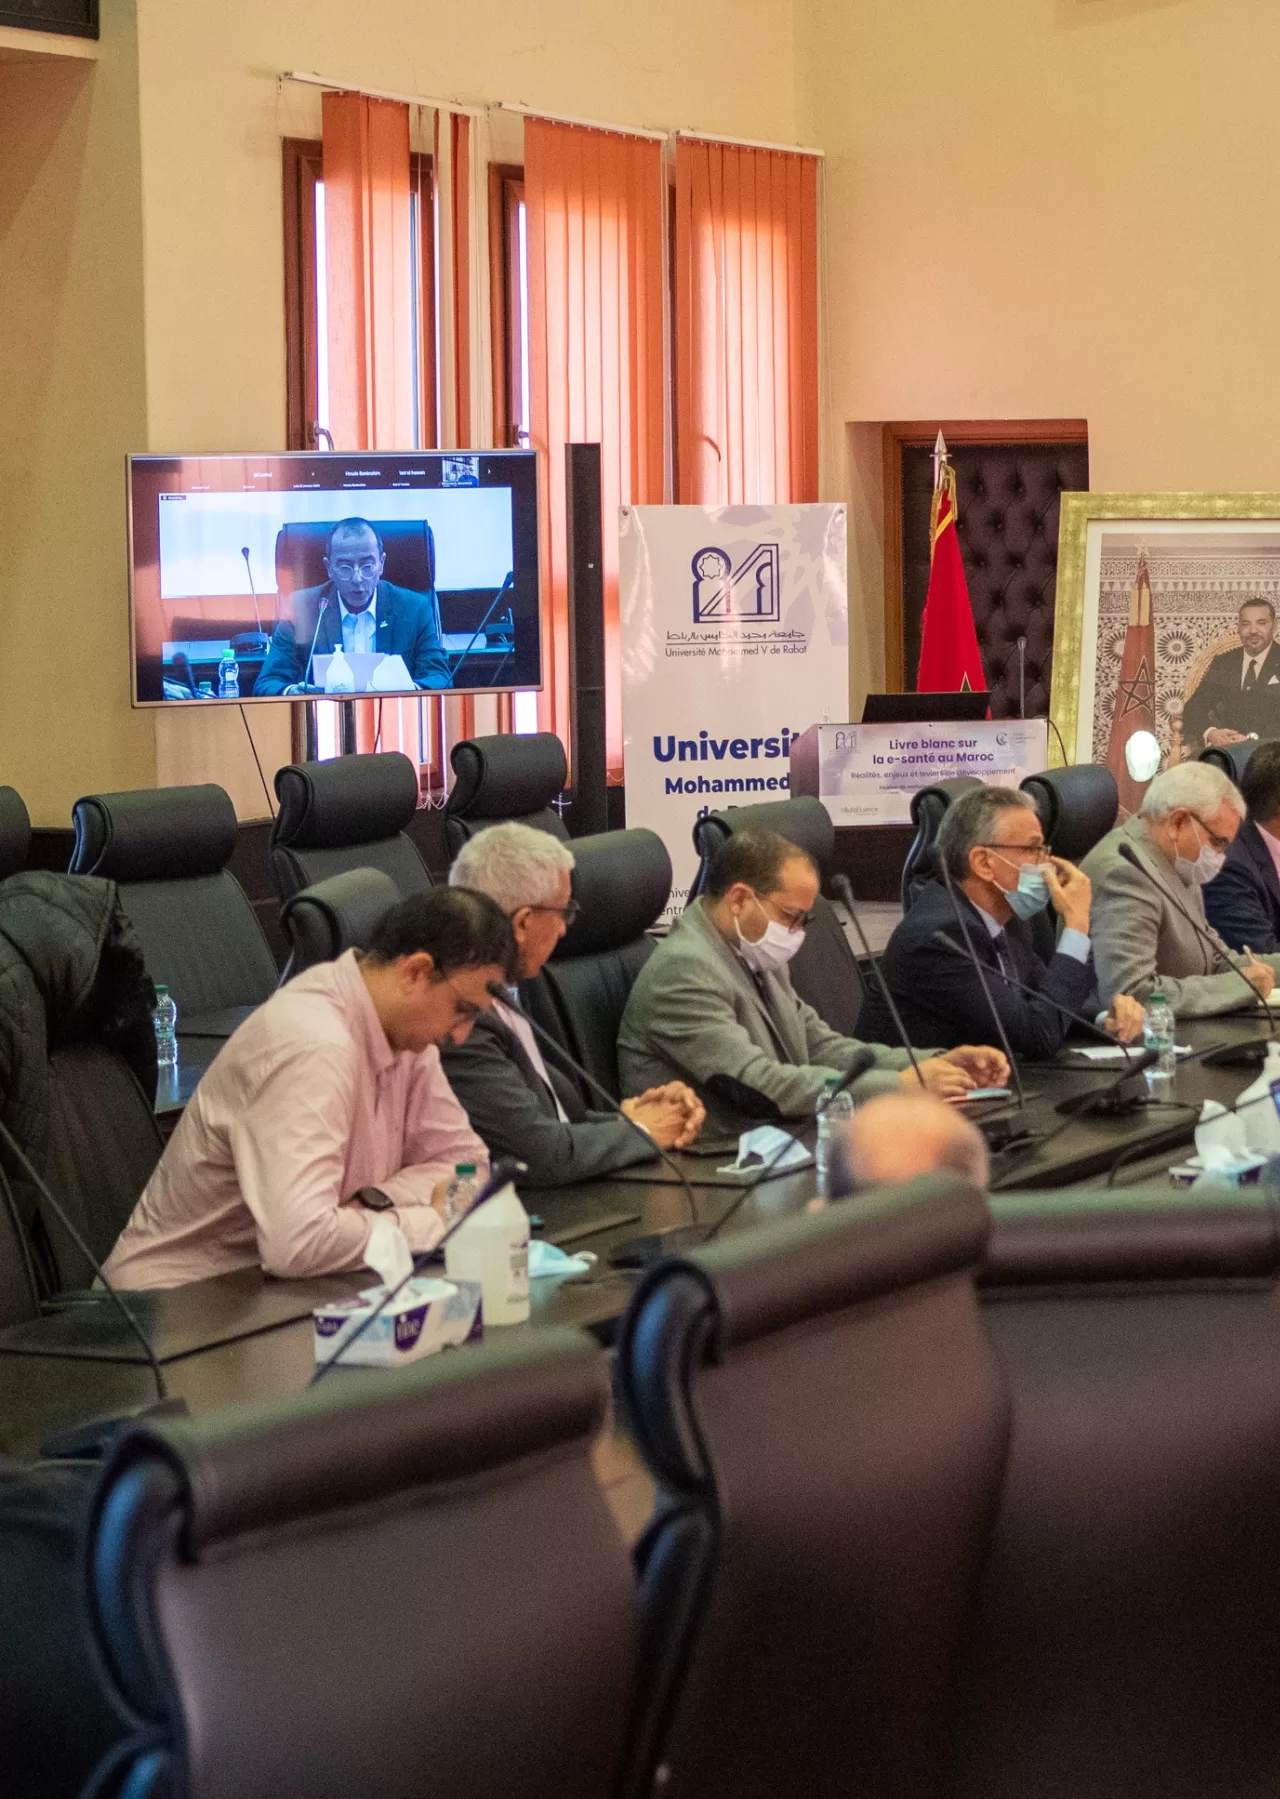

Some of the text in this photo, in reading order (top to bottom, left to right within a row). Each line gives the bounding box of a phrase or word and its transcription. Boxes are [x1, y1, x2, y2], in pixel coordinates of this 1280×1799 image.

[665, 647, 706, 657] Université
[761, 645, 769, 655] V
[770, 645, 781, 655] de
[783, 644, 807, 655] Rabat
[889, 737, 978, 751] Livre blanc sur
[873, 753, 885, 765] la
[887, 751, 936, 765] e-santé
[937, 753, 954, 764] au
[956, 751, 995, 763] Maroc
[883, 770, 909, 781] enjeux
[910, 769, 918, 779] et
[956, 767, 1016, 778] développement
[665, 772, 791, 795] Mohammed
[697, 805, 720, 820] d
